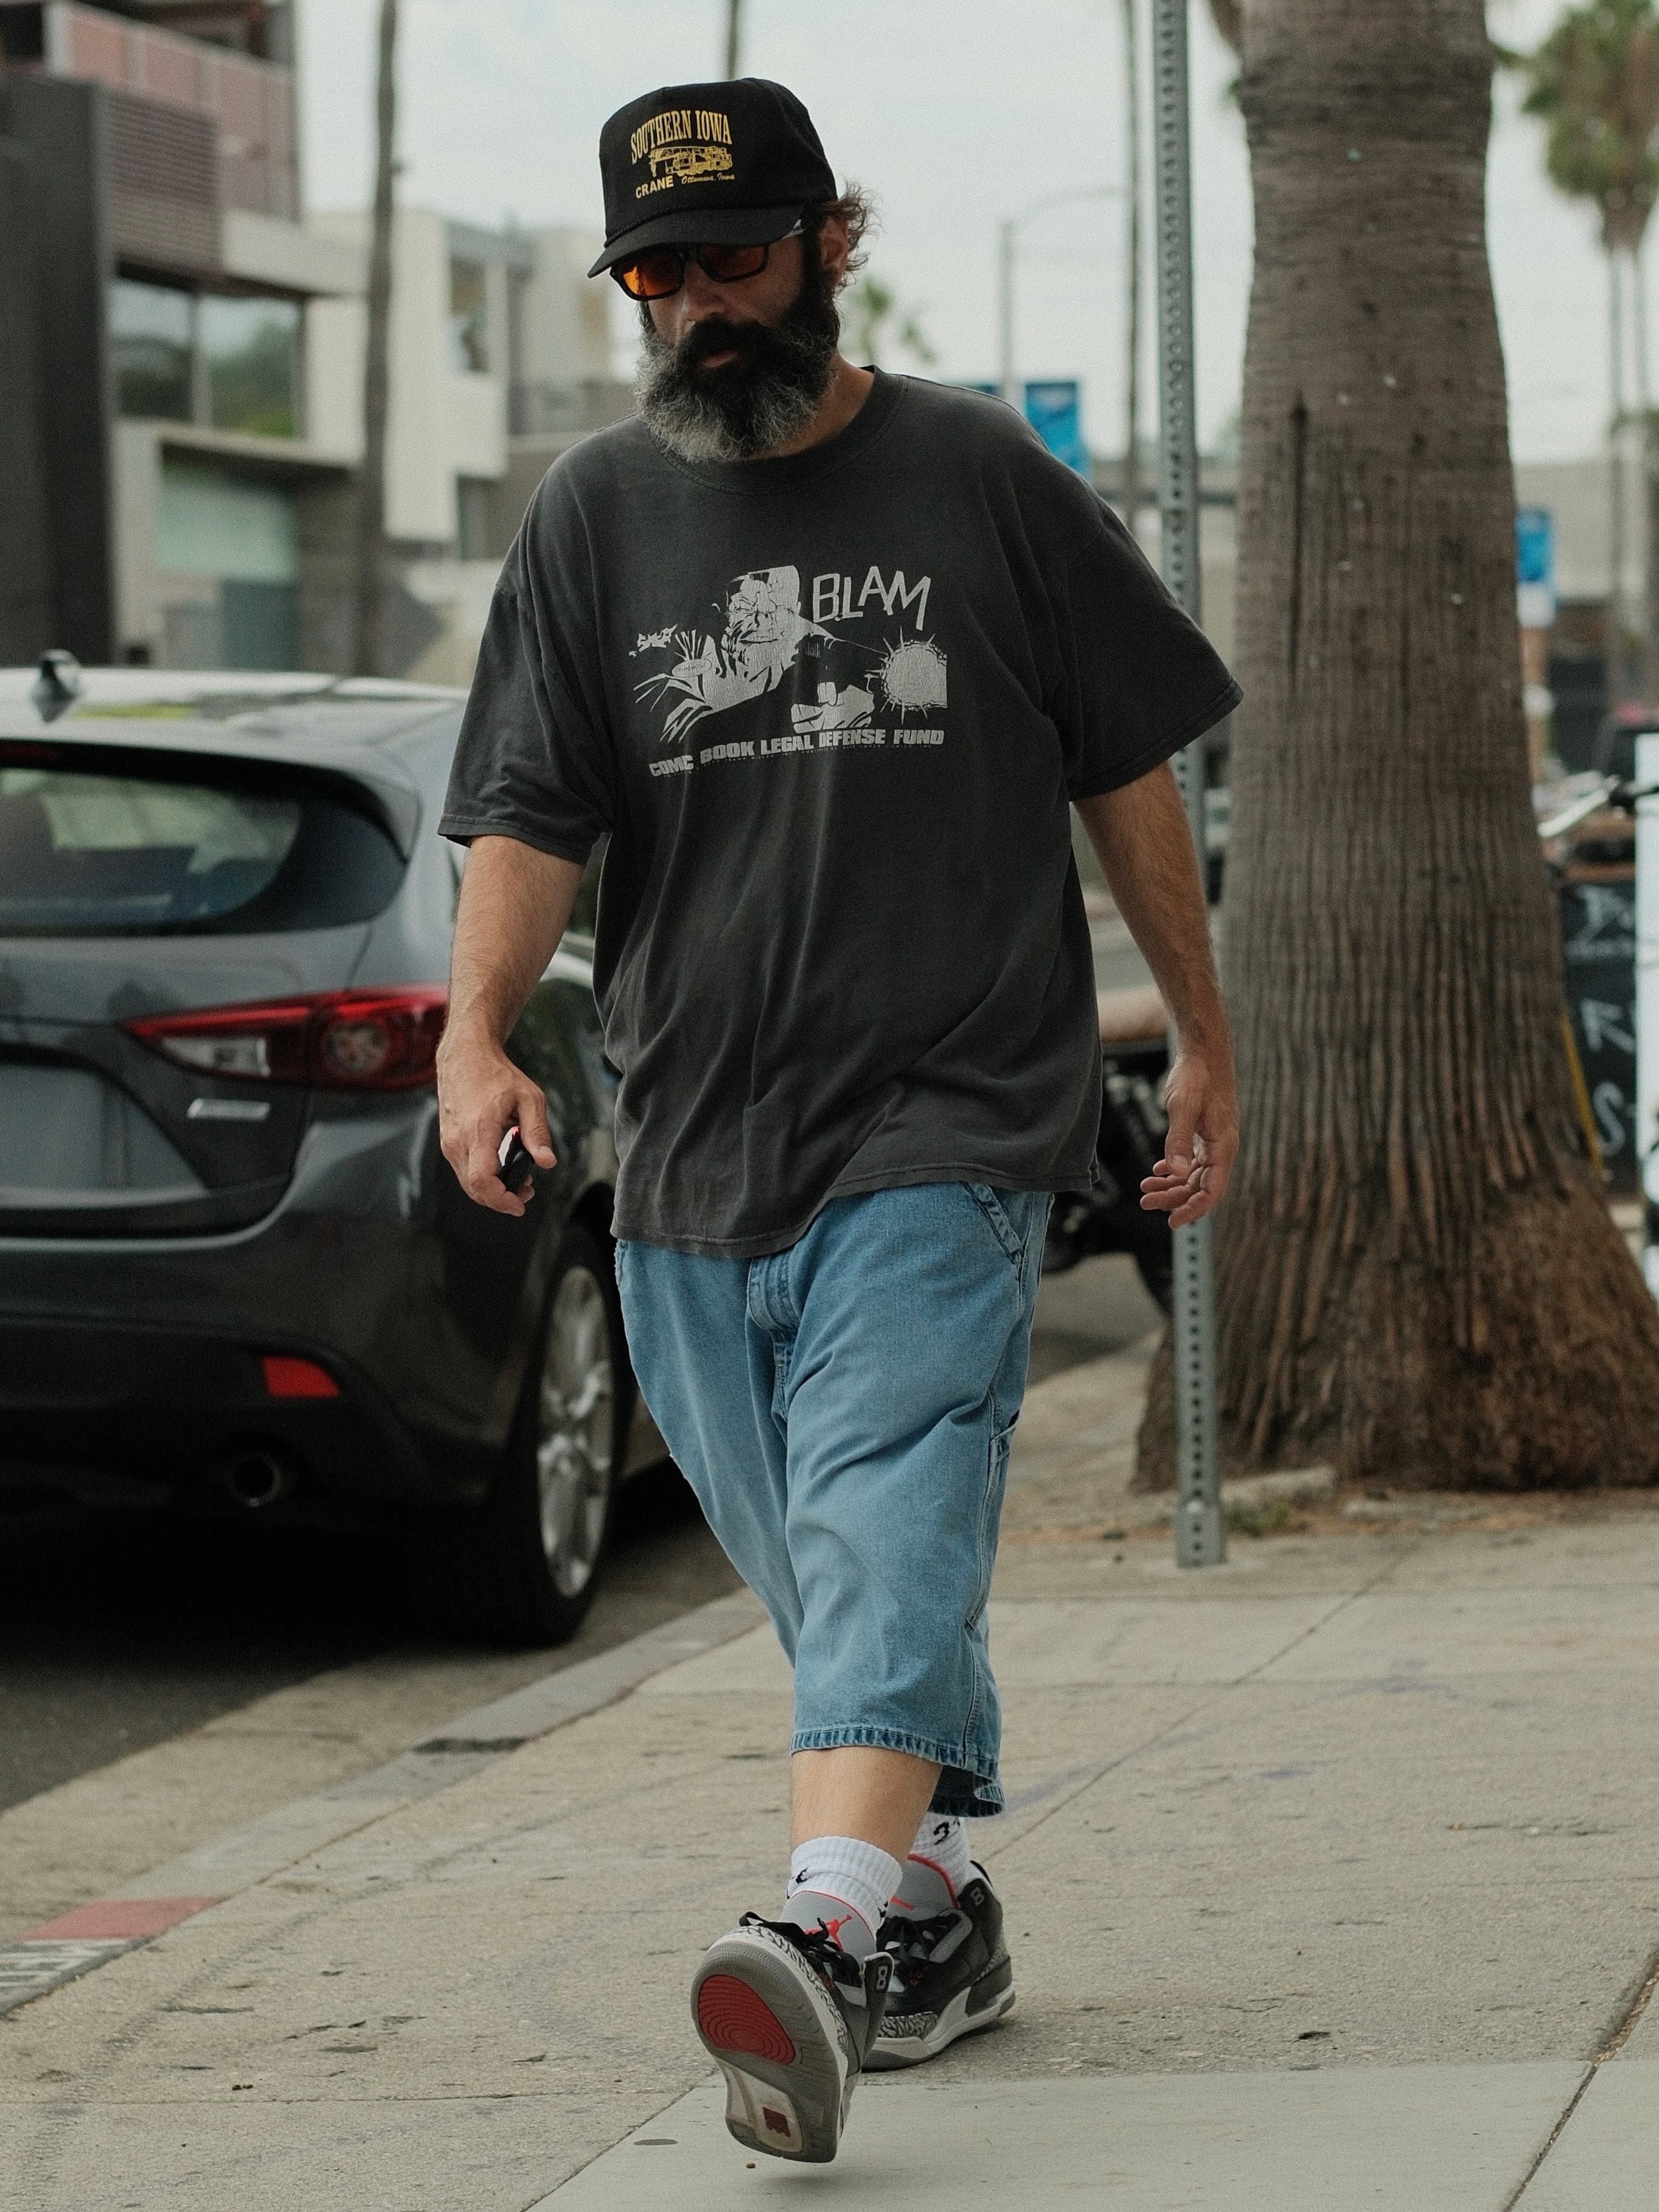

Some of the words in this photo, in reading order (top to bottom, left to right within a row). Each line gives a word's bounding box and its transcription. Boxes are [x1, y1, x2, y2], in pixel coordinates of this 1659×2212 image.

[631, 110, 692, 164] SOUTHERN
[695, 110, 732, 144] IOWA
[636, 175, 674, 199] CRANE
[812, 566, 931, 631] BLAM
[700, 741, 755, 764] BOOK
[761, 735, 814, 755] LEGAL
[819, 729, 886, 748] DEFENSE
[894, 729, 944, 745] FUND
